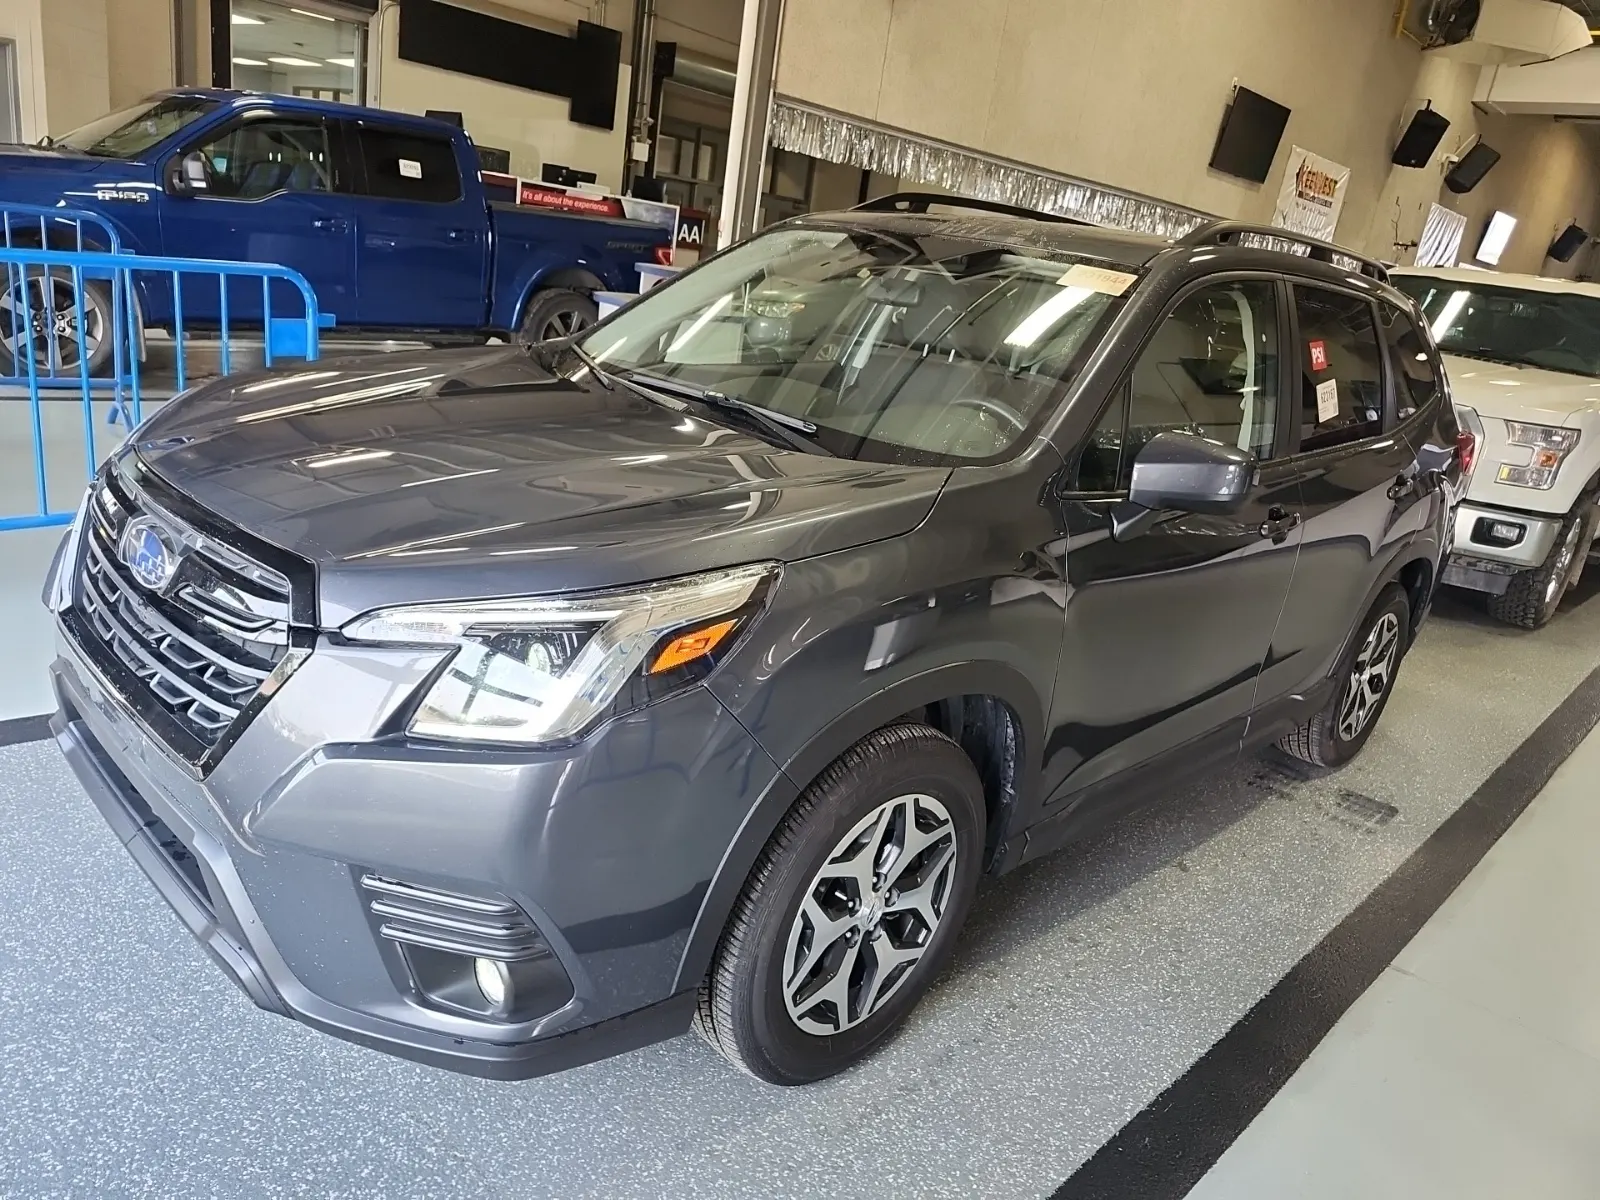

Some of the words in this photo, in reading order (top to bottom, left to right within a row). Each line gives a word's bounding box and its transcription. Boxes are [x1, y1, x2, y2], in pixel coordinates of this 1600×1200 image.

[522, 190, 533, 201] It's
[533, 193, 542, 203] all
[542, 194, 562, 205] about
[562, 197, 573, 207] the
[573, 200, 610, 213] experience.
[1311, 347, 1325, 364] PSI
